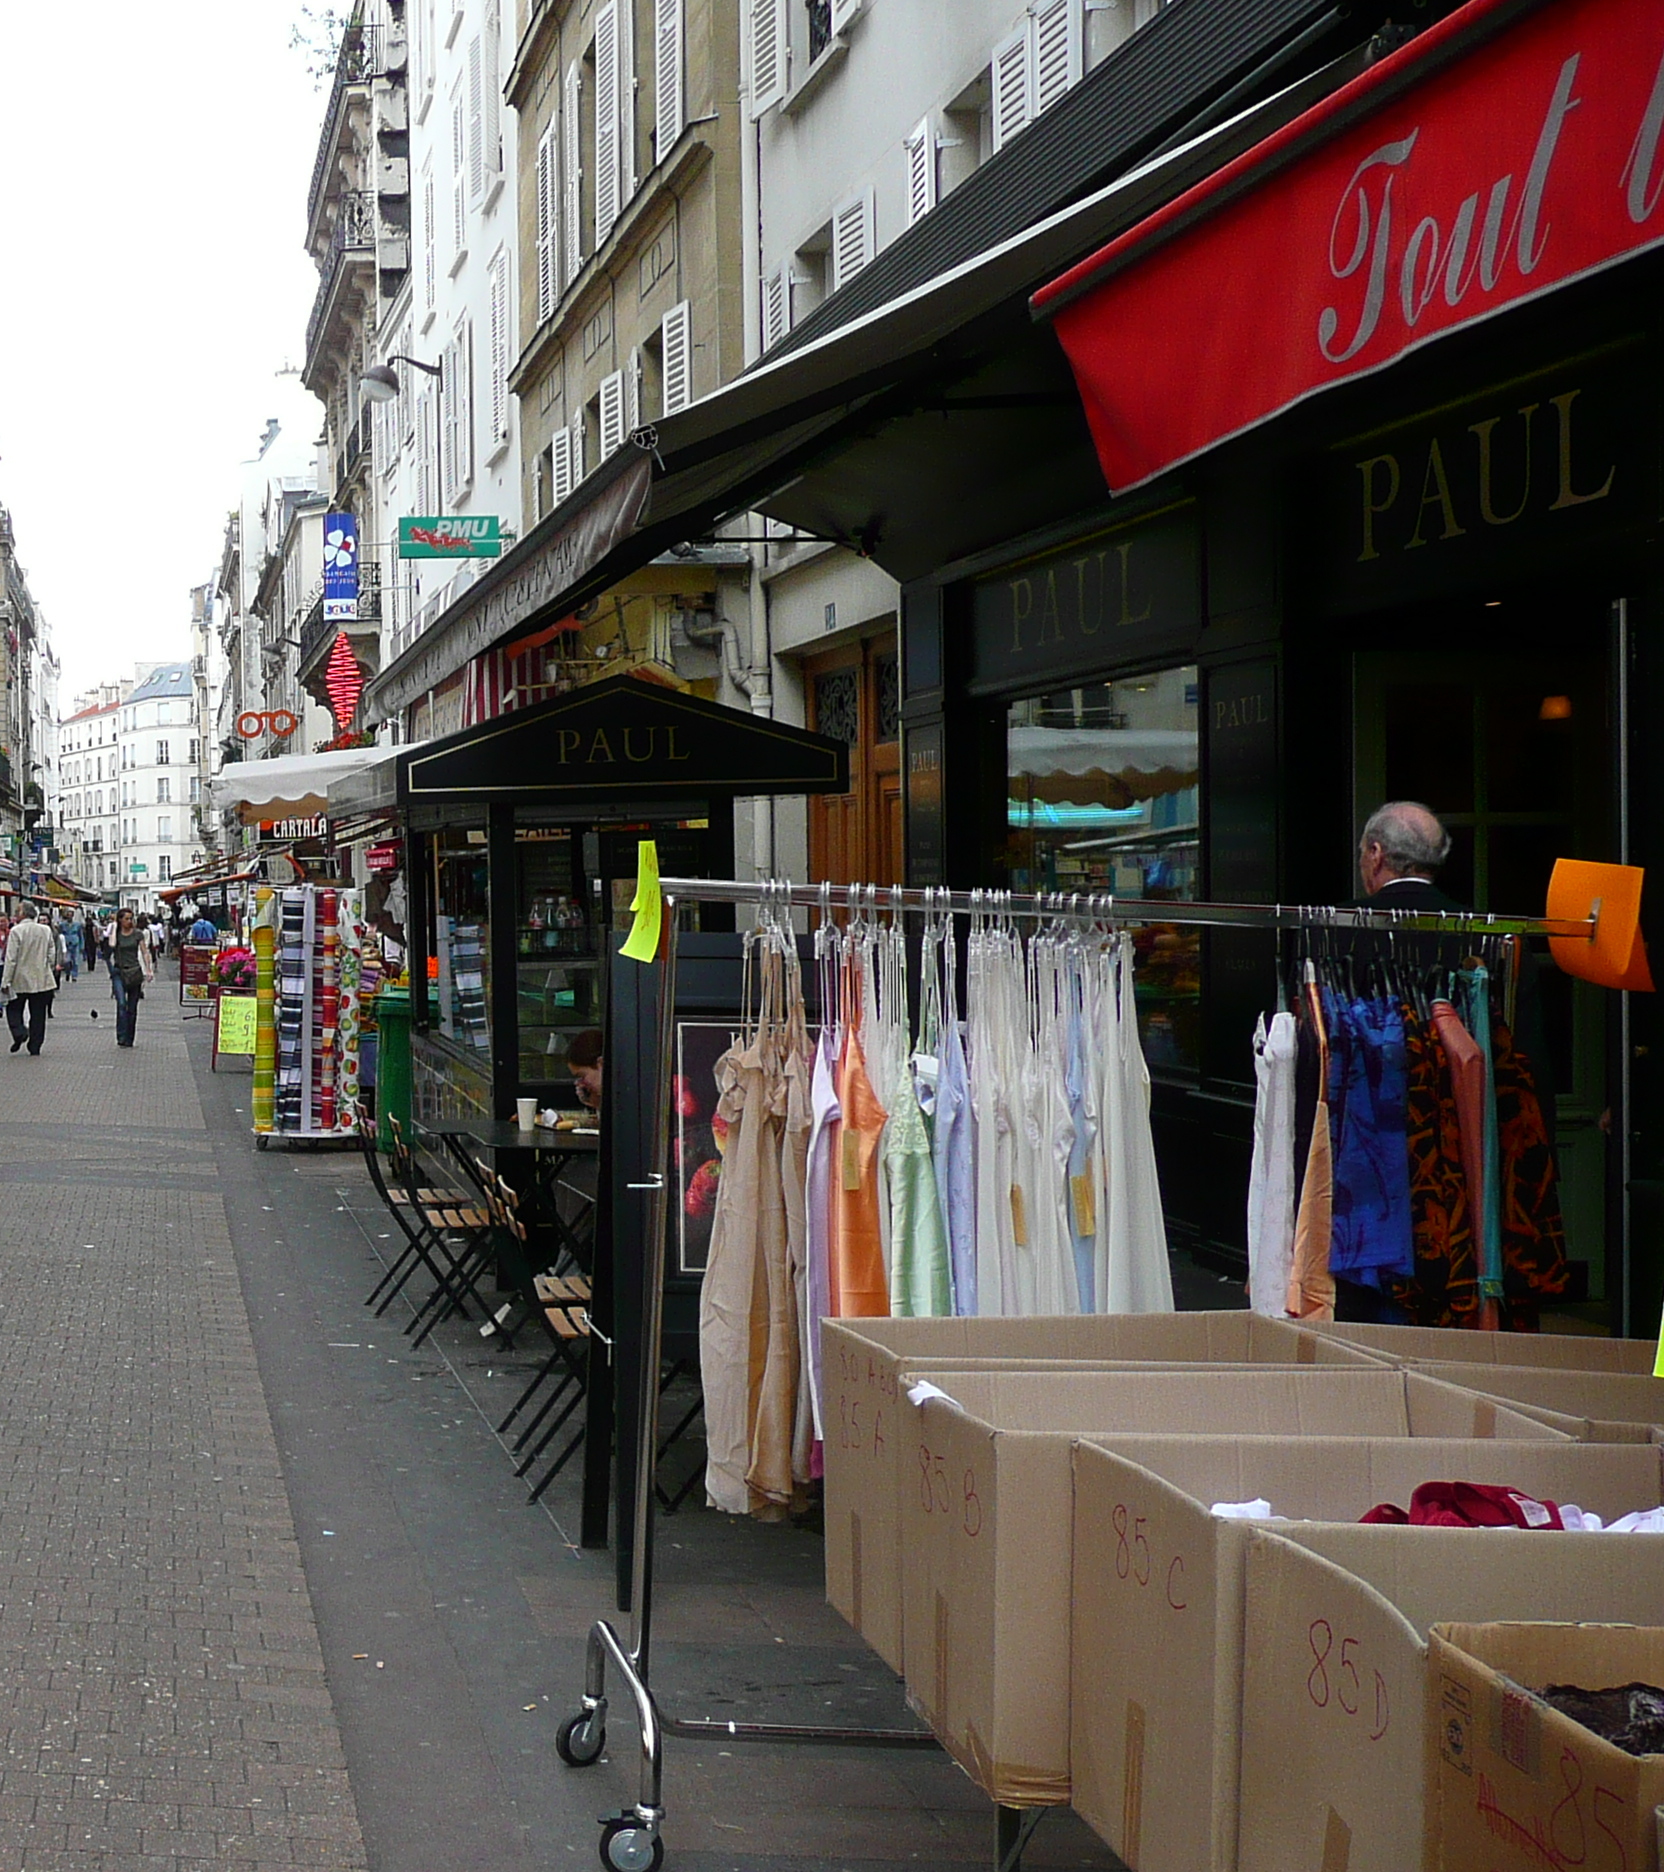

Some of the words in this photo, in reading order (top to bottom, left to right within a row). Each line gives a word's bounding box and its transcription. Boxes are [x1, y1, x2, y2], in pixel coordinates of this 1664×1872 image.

[1319, 52, 1581, 363] Tout
[436, 519, 489, 538] PMU
[1356, 390, 1615, 562] PAUL
[1010, 543, 1152, 654] PAUL
[557, 726, 691, 765] PAUL
[910, 749, 939, 774] PAUL
[1215, 694, 1269, 731] PAUL
[918, 1445, 949, 1513] 85
[963, 1469, 982, 1537] B
[1112, 1504, 1150, 1586] 85
[1167, 1556, 1187, 1610] C
[1308, 1619, 1360, 1715] 85
[1369, 1669, 1389, 1741] D
[1550, 1746, 1627, 1872] 85
